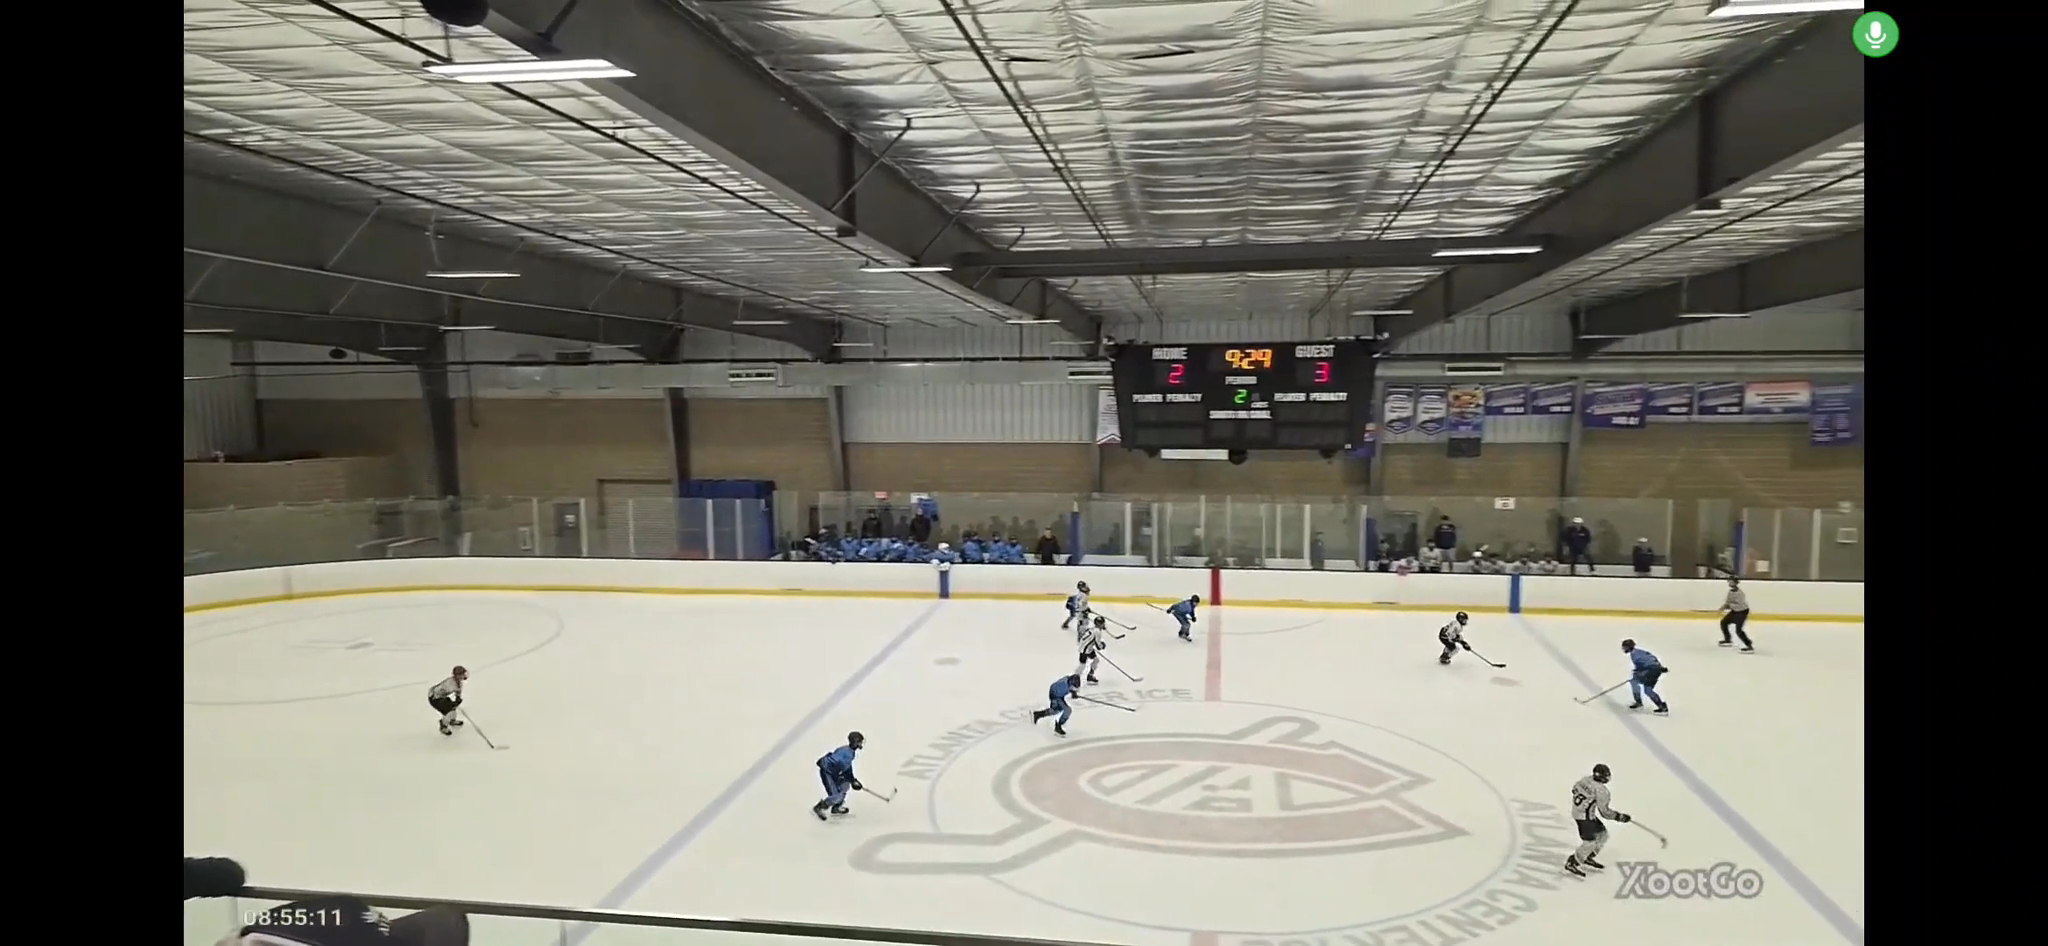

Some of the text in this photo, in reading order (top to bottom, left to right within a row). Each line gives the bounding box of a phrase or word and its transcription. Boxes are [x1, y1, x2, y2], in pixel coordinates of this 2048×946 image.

[1225, 349, 1273, 369] 9:29
[1295, 345, 1335, 358] GUEST
[1169, 364, 1184, 385] 2
[1314, 362, 1330, 383] 3
[1234, 389, 1248, 404] 2
[1133, 688, 1193, 700] ICE
